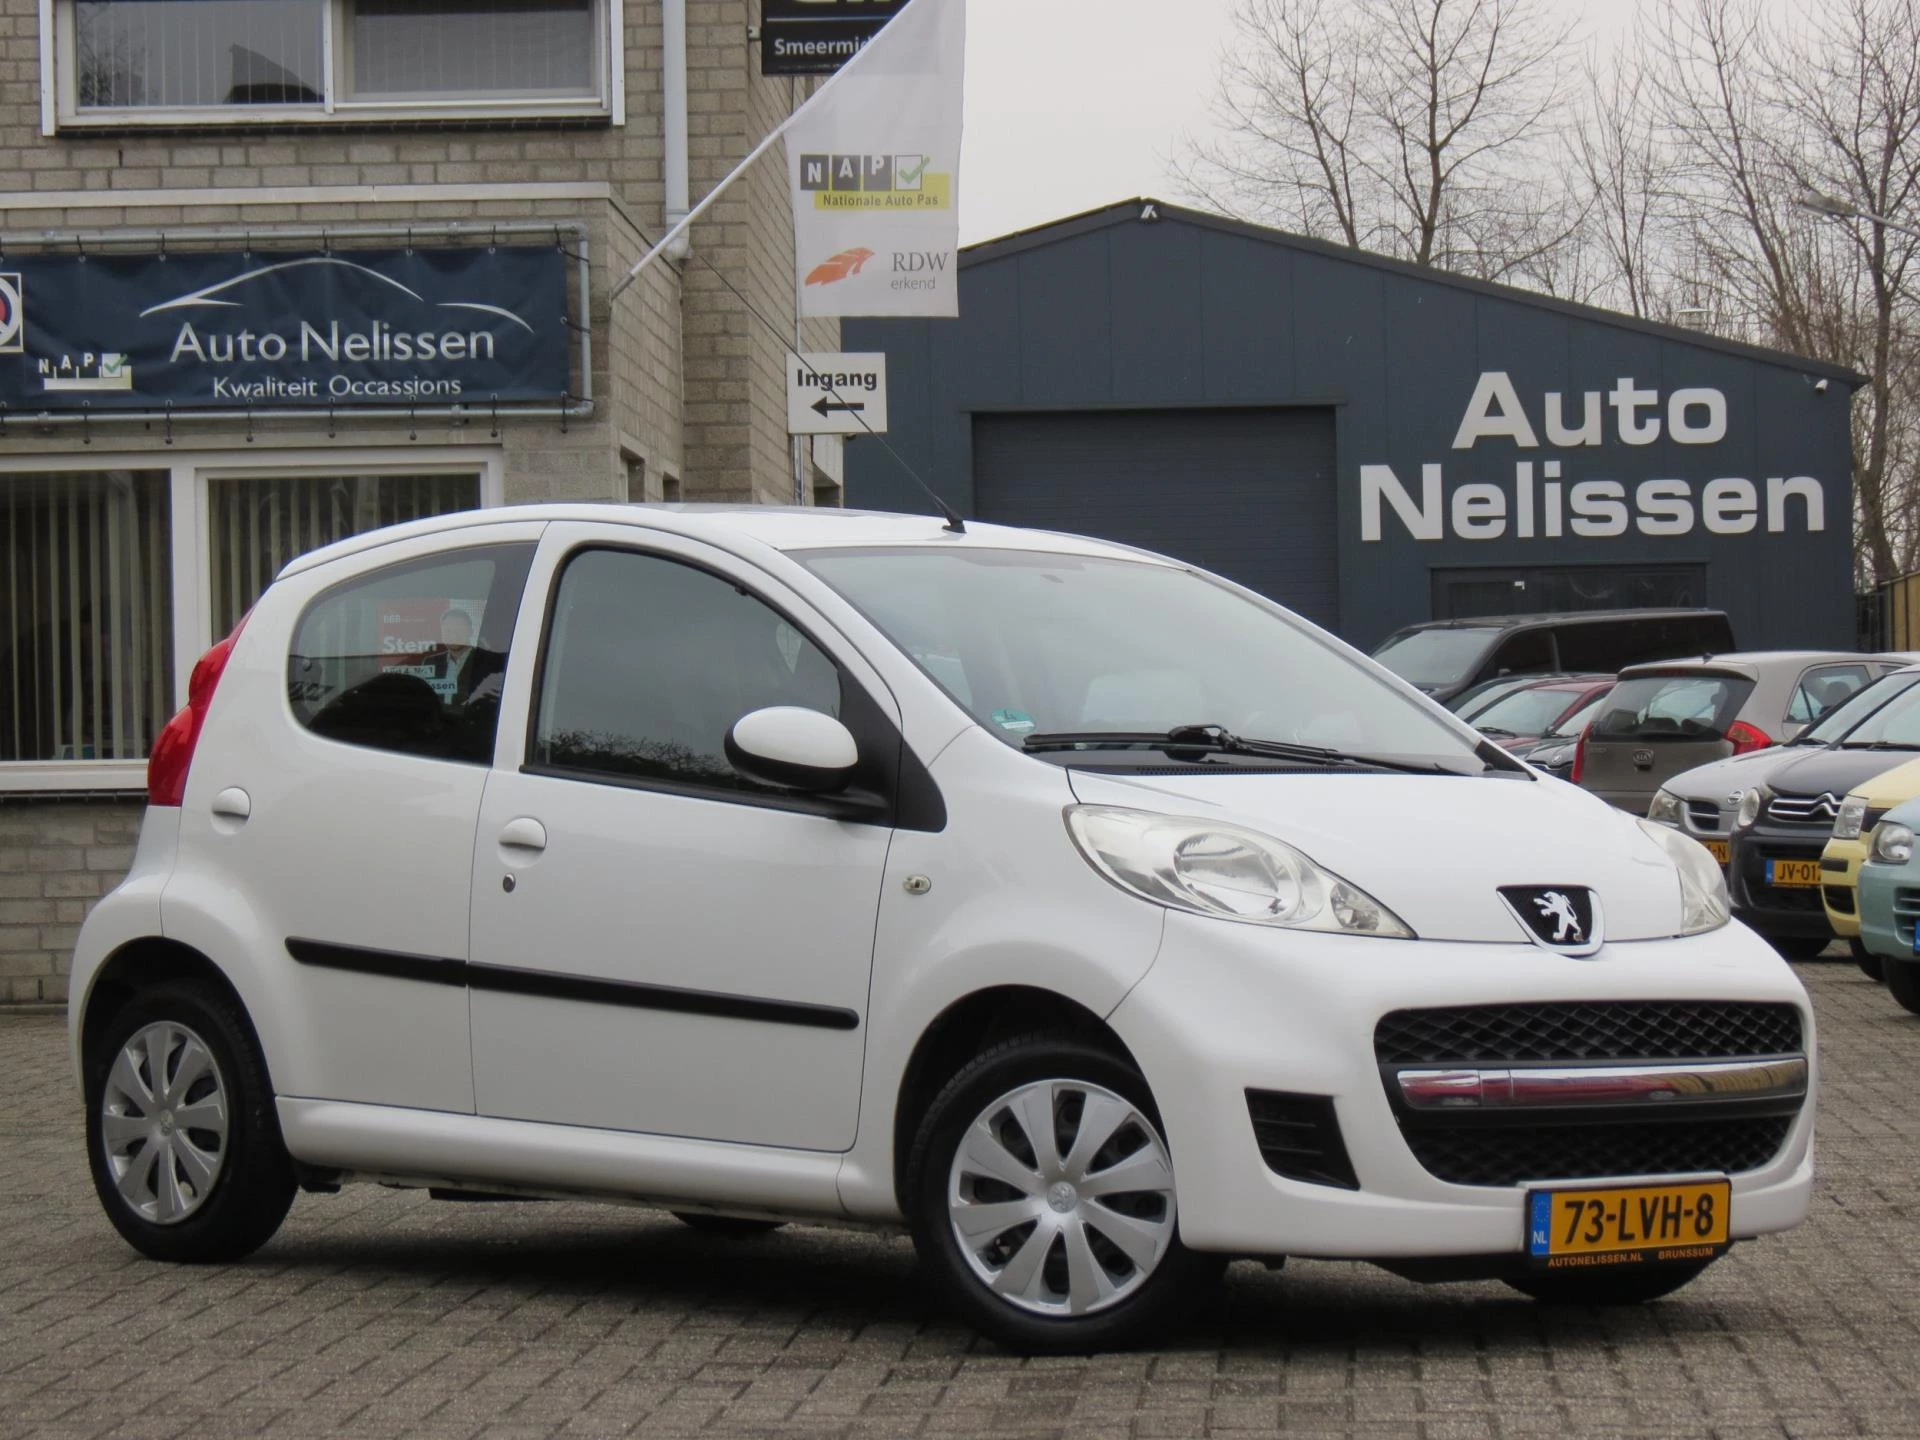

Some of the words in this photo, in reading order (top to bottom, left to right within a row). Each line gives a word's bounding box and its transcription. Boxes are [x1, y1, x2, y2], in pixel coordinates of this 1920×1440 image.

[823, 194, 881, 207] Nationale
[884, 194, 913, 206] Auto
[917, 193, 938, 205] Pas
[892, 252, 948, 272] RDW
[890, 276, 936, 290] erkend
[169, 321, 287, 363] Auto
[300, 319, 494, 361] Nelissen
[213, 375, 318, 398] Kwaliteit
[328, 374, 461, 396] Occassions
[797, 369, 877, 391] Ingang
[1451, 371, 1727, 449] Auto
[1360, 460, 1825, 541] Nelissen
[382, 636, 437, 654] Stem
[1564, 1193, 1714, 1245] 73-LVH-8
[1533, 1231, 1547, 1244] NL
[1548, 1252, 1644, 1268] AUTONELISSEN.NL
[1658, 1247, 1714, 1261] BRUNSSUM
